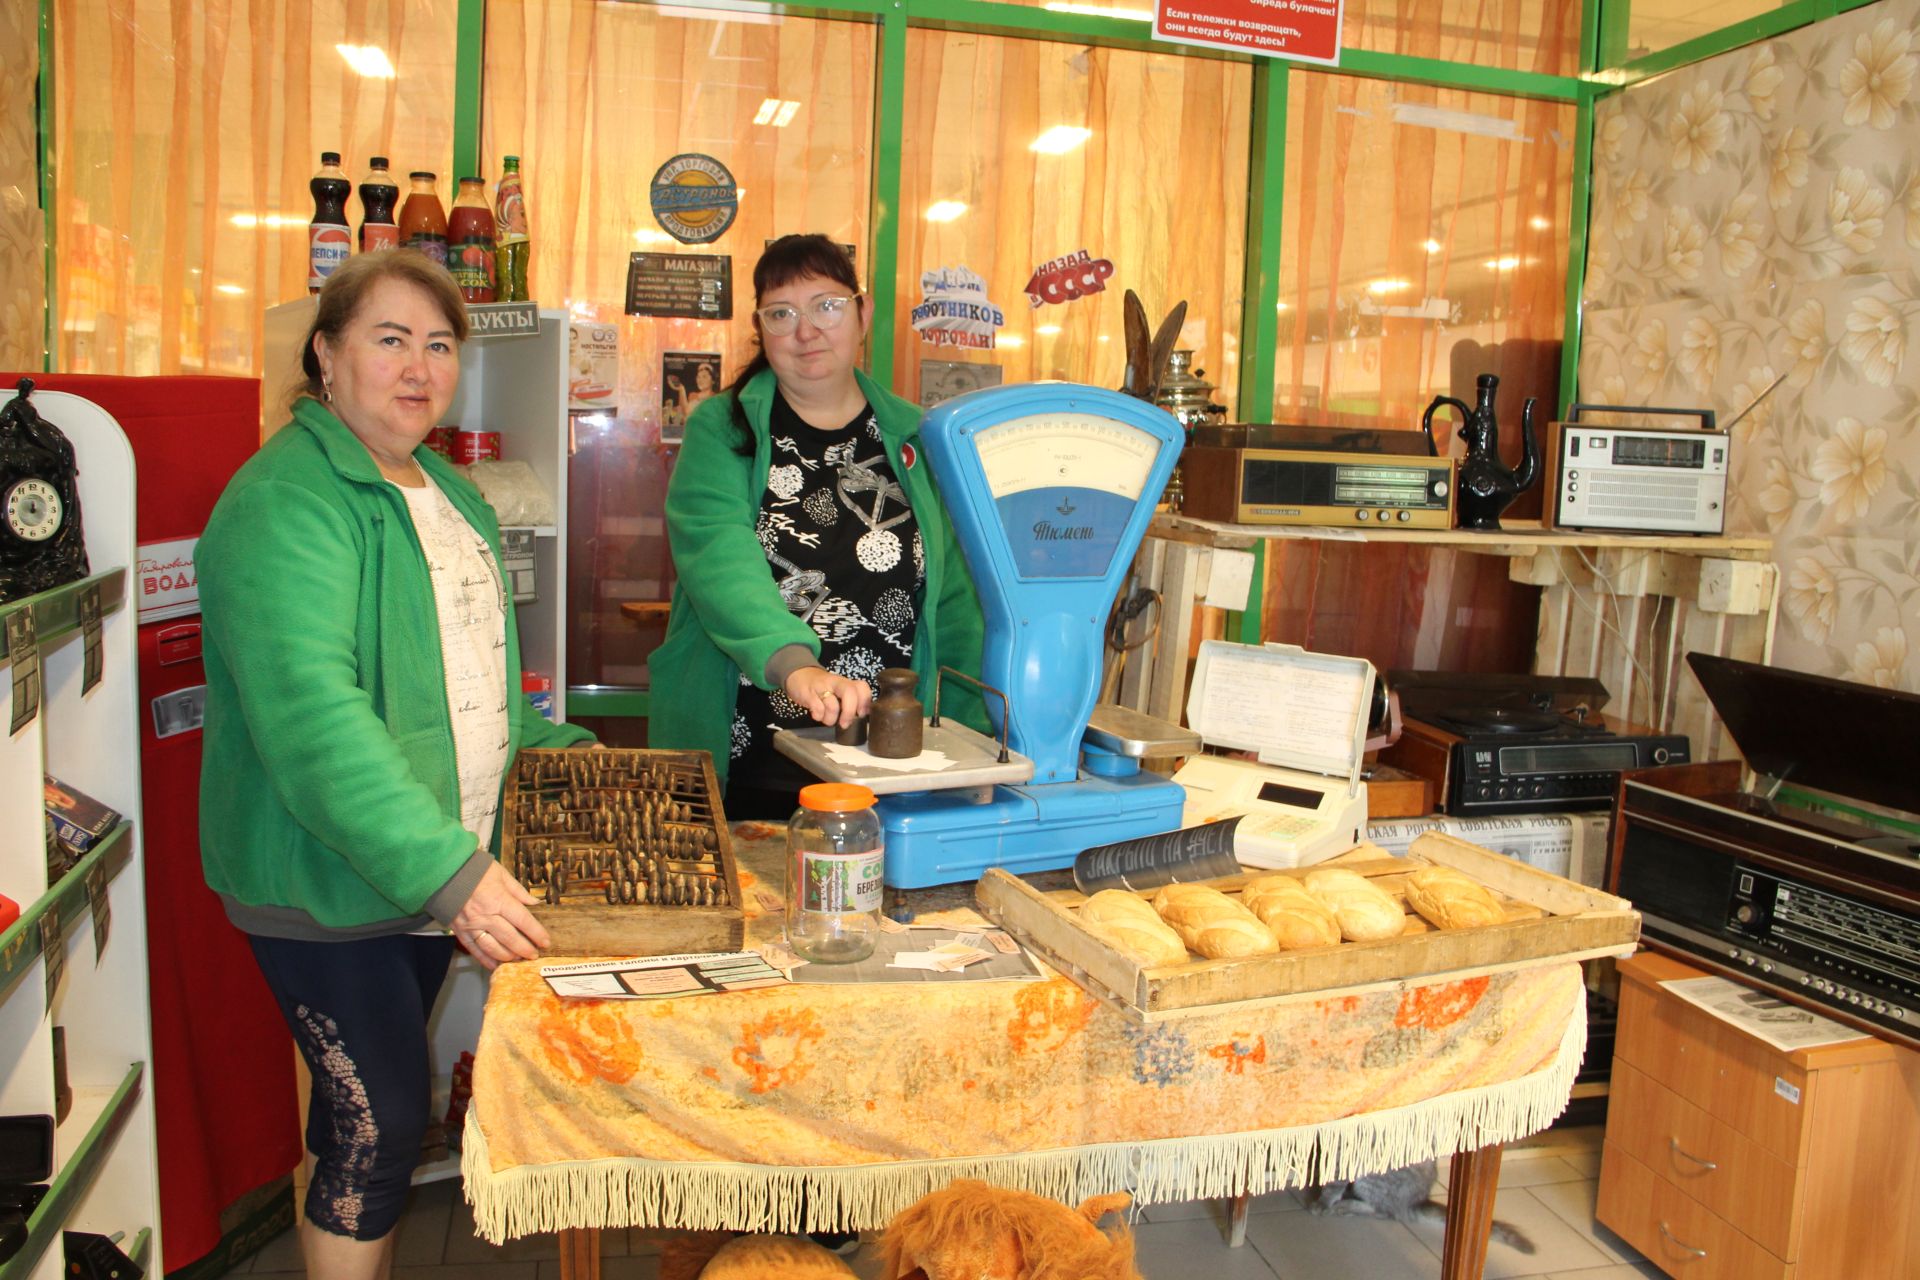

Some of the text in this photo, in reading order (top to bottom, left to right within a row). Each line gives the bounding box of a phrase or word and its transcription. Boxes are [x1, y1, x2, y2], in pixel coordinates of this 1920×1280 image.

[1289, 1, 1336, 17] булачак!
[1165, 22, 1286, 48] они всегда будут здесь!
[1166, 8, 1303, 38] Если тележки возвращать,
[664, 258, 723, 273] МАГАЗИН
[1037, 249, 1092, 277] НАЗАД
[1038, 259, 1114, 305] СССР
[467, 310, 535, 332] ДУКТЫ
[1032, 520, 1095, 541] Тюмень
[1162, 832, 1183, 863] НА
[542, 960, 618, 973] Продуктовые
